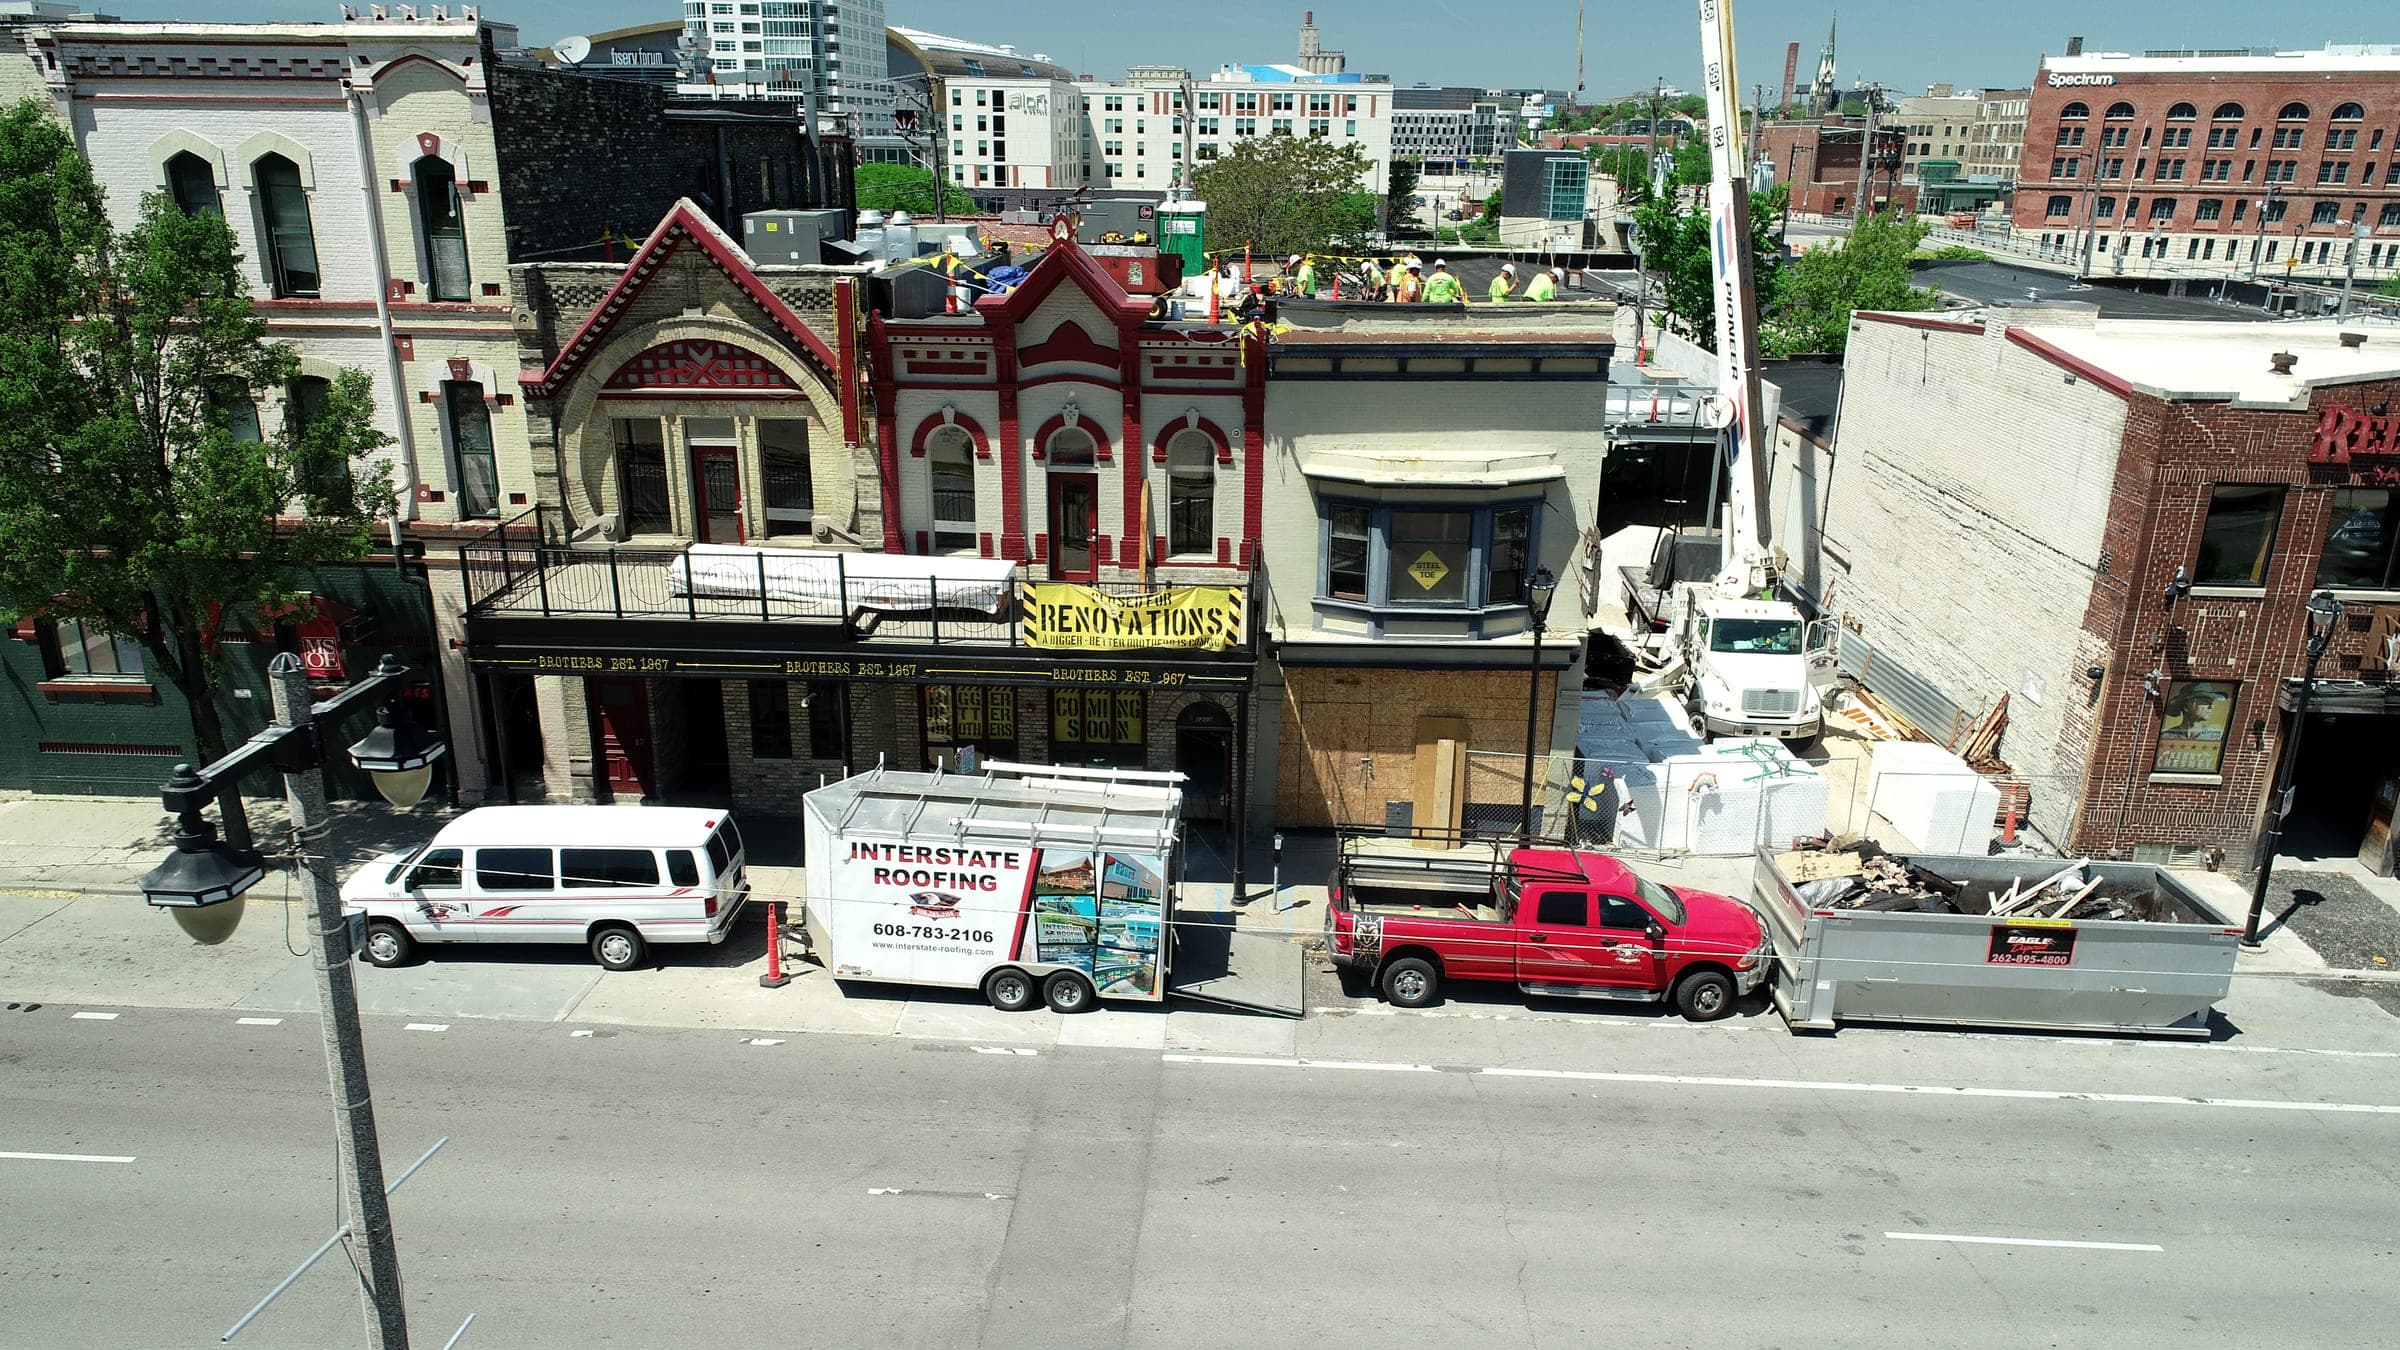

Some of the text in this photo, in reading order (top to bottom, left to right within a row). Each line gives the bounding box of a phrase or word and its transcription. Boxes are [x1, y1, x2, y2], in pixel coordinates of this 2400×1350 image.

[639, 47, 664, 65] forum
[2048, 73, 2113, 88] Spectrum
[1725, 282, 1738, 380] PIONEER
[1146, 593, 1172, 608] FOR
[1041, 603, 1222, 637] RENOVATIONS
[306, 639, 335, 653] MS
[1050, 635, 1083, 646] BIGGER
[307, 653, 338, 668] OE
[539, 655, 603, 669] BROTHERS
[640, 657, 669, 670] 1967
[786, 661, 850, 674] BROTHERS
[888, 664, 917, 677] 1967
[1053, 668, 1117, 682] BROTHERS
[1158, 672, 1186, 686] 967
[1056, 698, 1140, 719] COMING
[1067, 719, 1129, 740] SOON
[851, 842, 1020, 870] INTERSTATE
[874, 868, 997, 892] ROOFING
[873, 923, 993, 943] 608-783-2106
[872, 941, 994, 956] www.interstate-roofing.com
[1992, 953, 2068, 964] 262-895-4800
